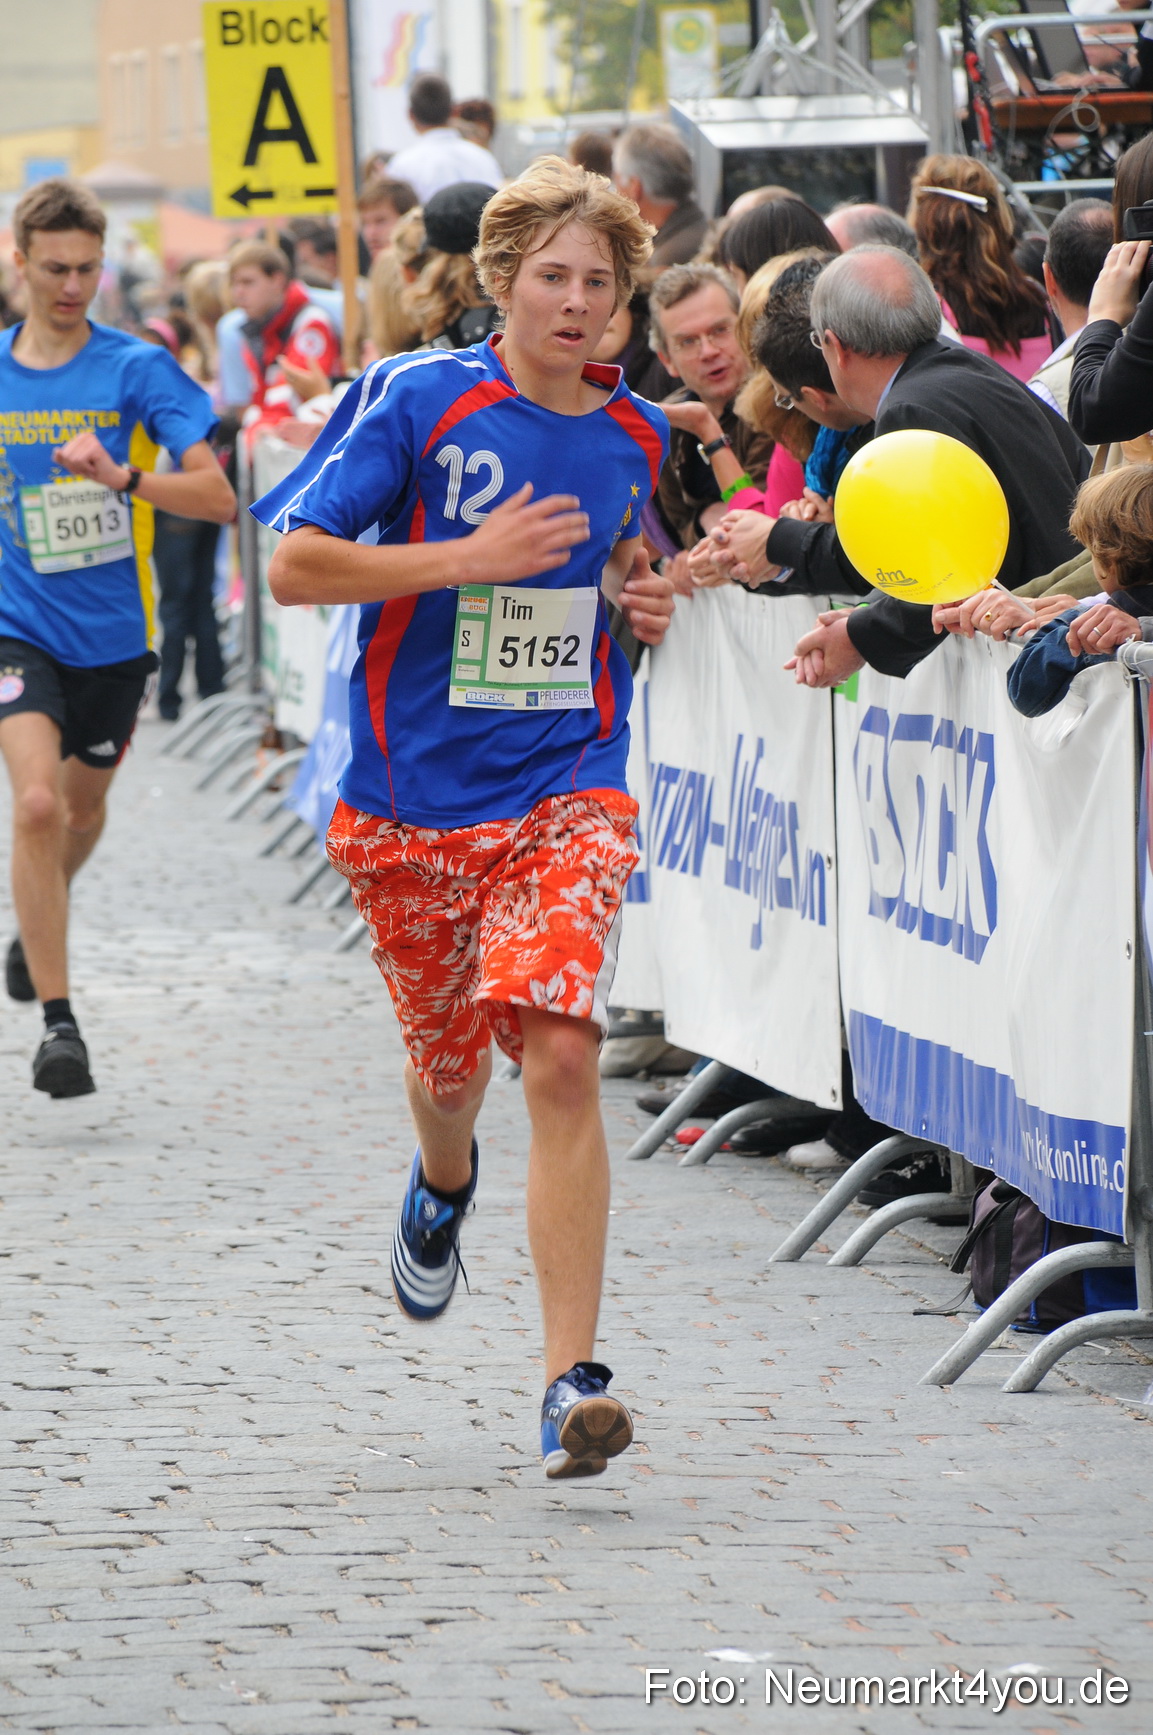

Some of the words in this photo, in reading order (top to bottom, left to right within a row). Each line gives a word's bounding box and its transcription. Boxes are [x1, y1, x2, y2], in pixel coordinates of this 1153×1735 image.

[220, 9, 330, 45] Block
[244, 66, 318, 166] A
[435, 444, 504, 525] 12
[56, 510, 120, 540] 5013
[876, 568, 906, 582] dm
[501, 596, 533, 620] Tim
[461, 630, 471, 647] S
[498, 635, 581, 669] 5152
[466, 691, 505, 702] BOCK
[540, 690, 590, 700] PFLEIDERER
